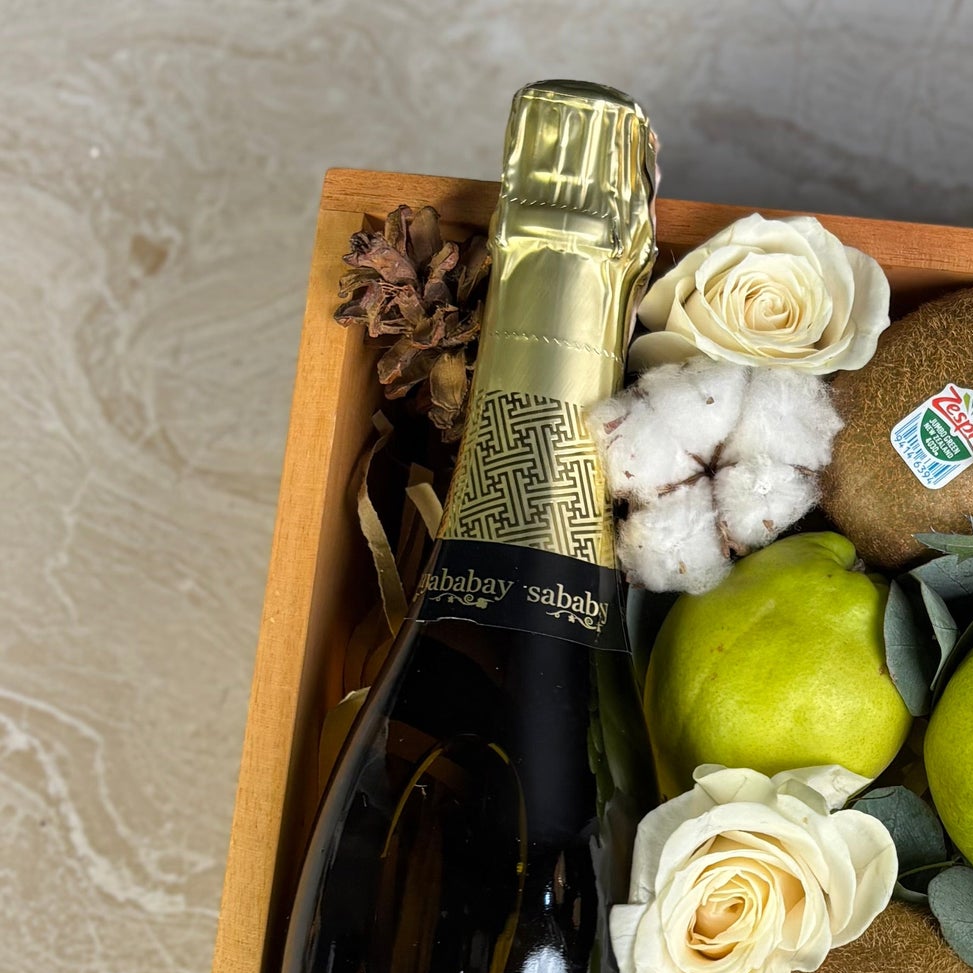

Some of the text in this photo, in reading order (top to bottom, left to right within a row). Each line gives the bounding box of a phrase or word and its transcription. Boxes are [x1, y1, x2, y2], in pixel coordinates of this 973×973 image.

[923, 422, 954, 459] NEW ZEALAND
[929, 418, 961, 454] JUMBO GREEN
[894, 434, 935, 484] 9414 6394
